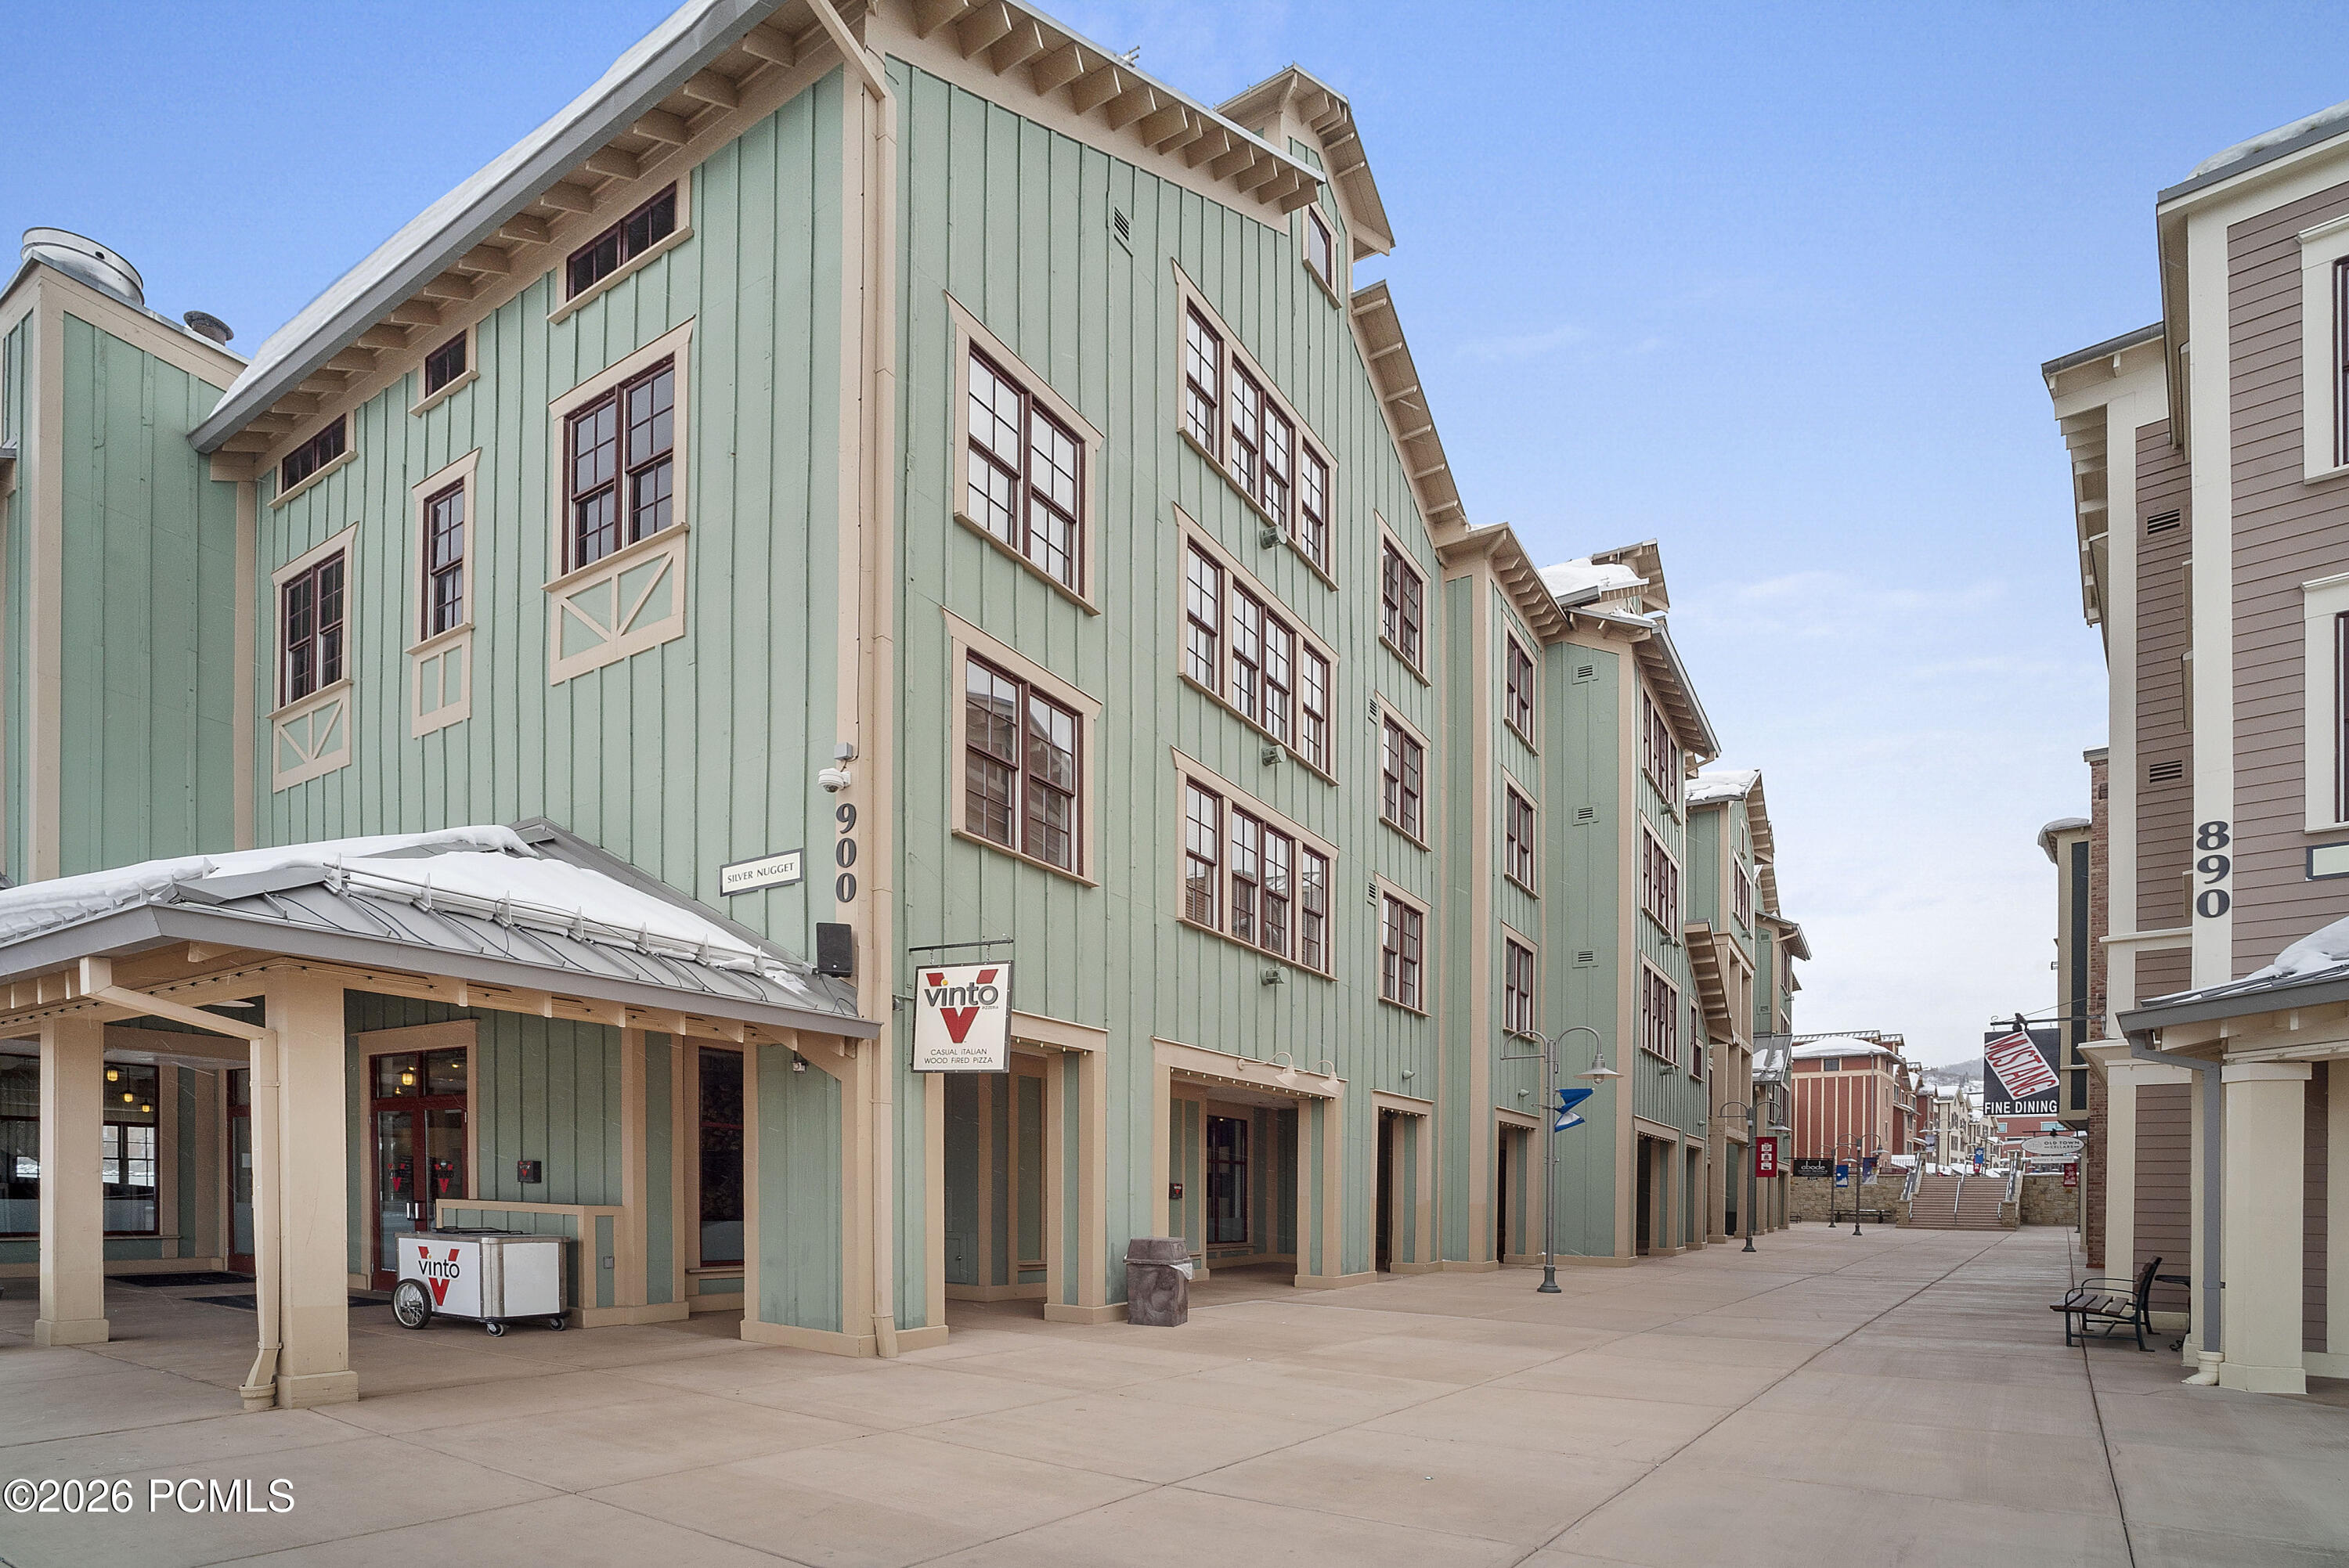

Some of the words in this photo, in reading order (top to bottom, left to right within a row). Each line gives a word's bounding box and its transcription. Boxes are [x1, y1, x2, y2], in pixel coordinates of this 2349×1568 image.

[835, 802, 857, 903] 900
[727, 871, 753, 884] SILVER
[756, 862, 795, 877] NUGGET
[2196, 820, 2231, 918] 890
[924, 979, 999, 1007] vinto
[1984, 1031, 2057, 1098] MUSTANG
[1984, 1101, 2011, 1114] FINE
[2015, 1100, 2058, 1113] DINING
[1801, 1160, 1826, 1170] abode
[418, 1254, 460, 1278] vinto
